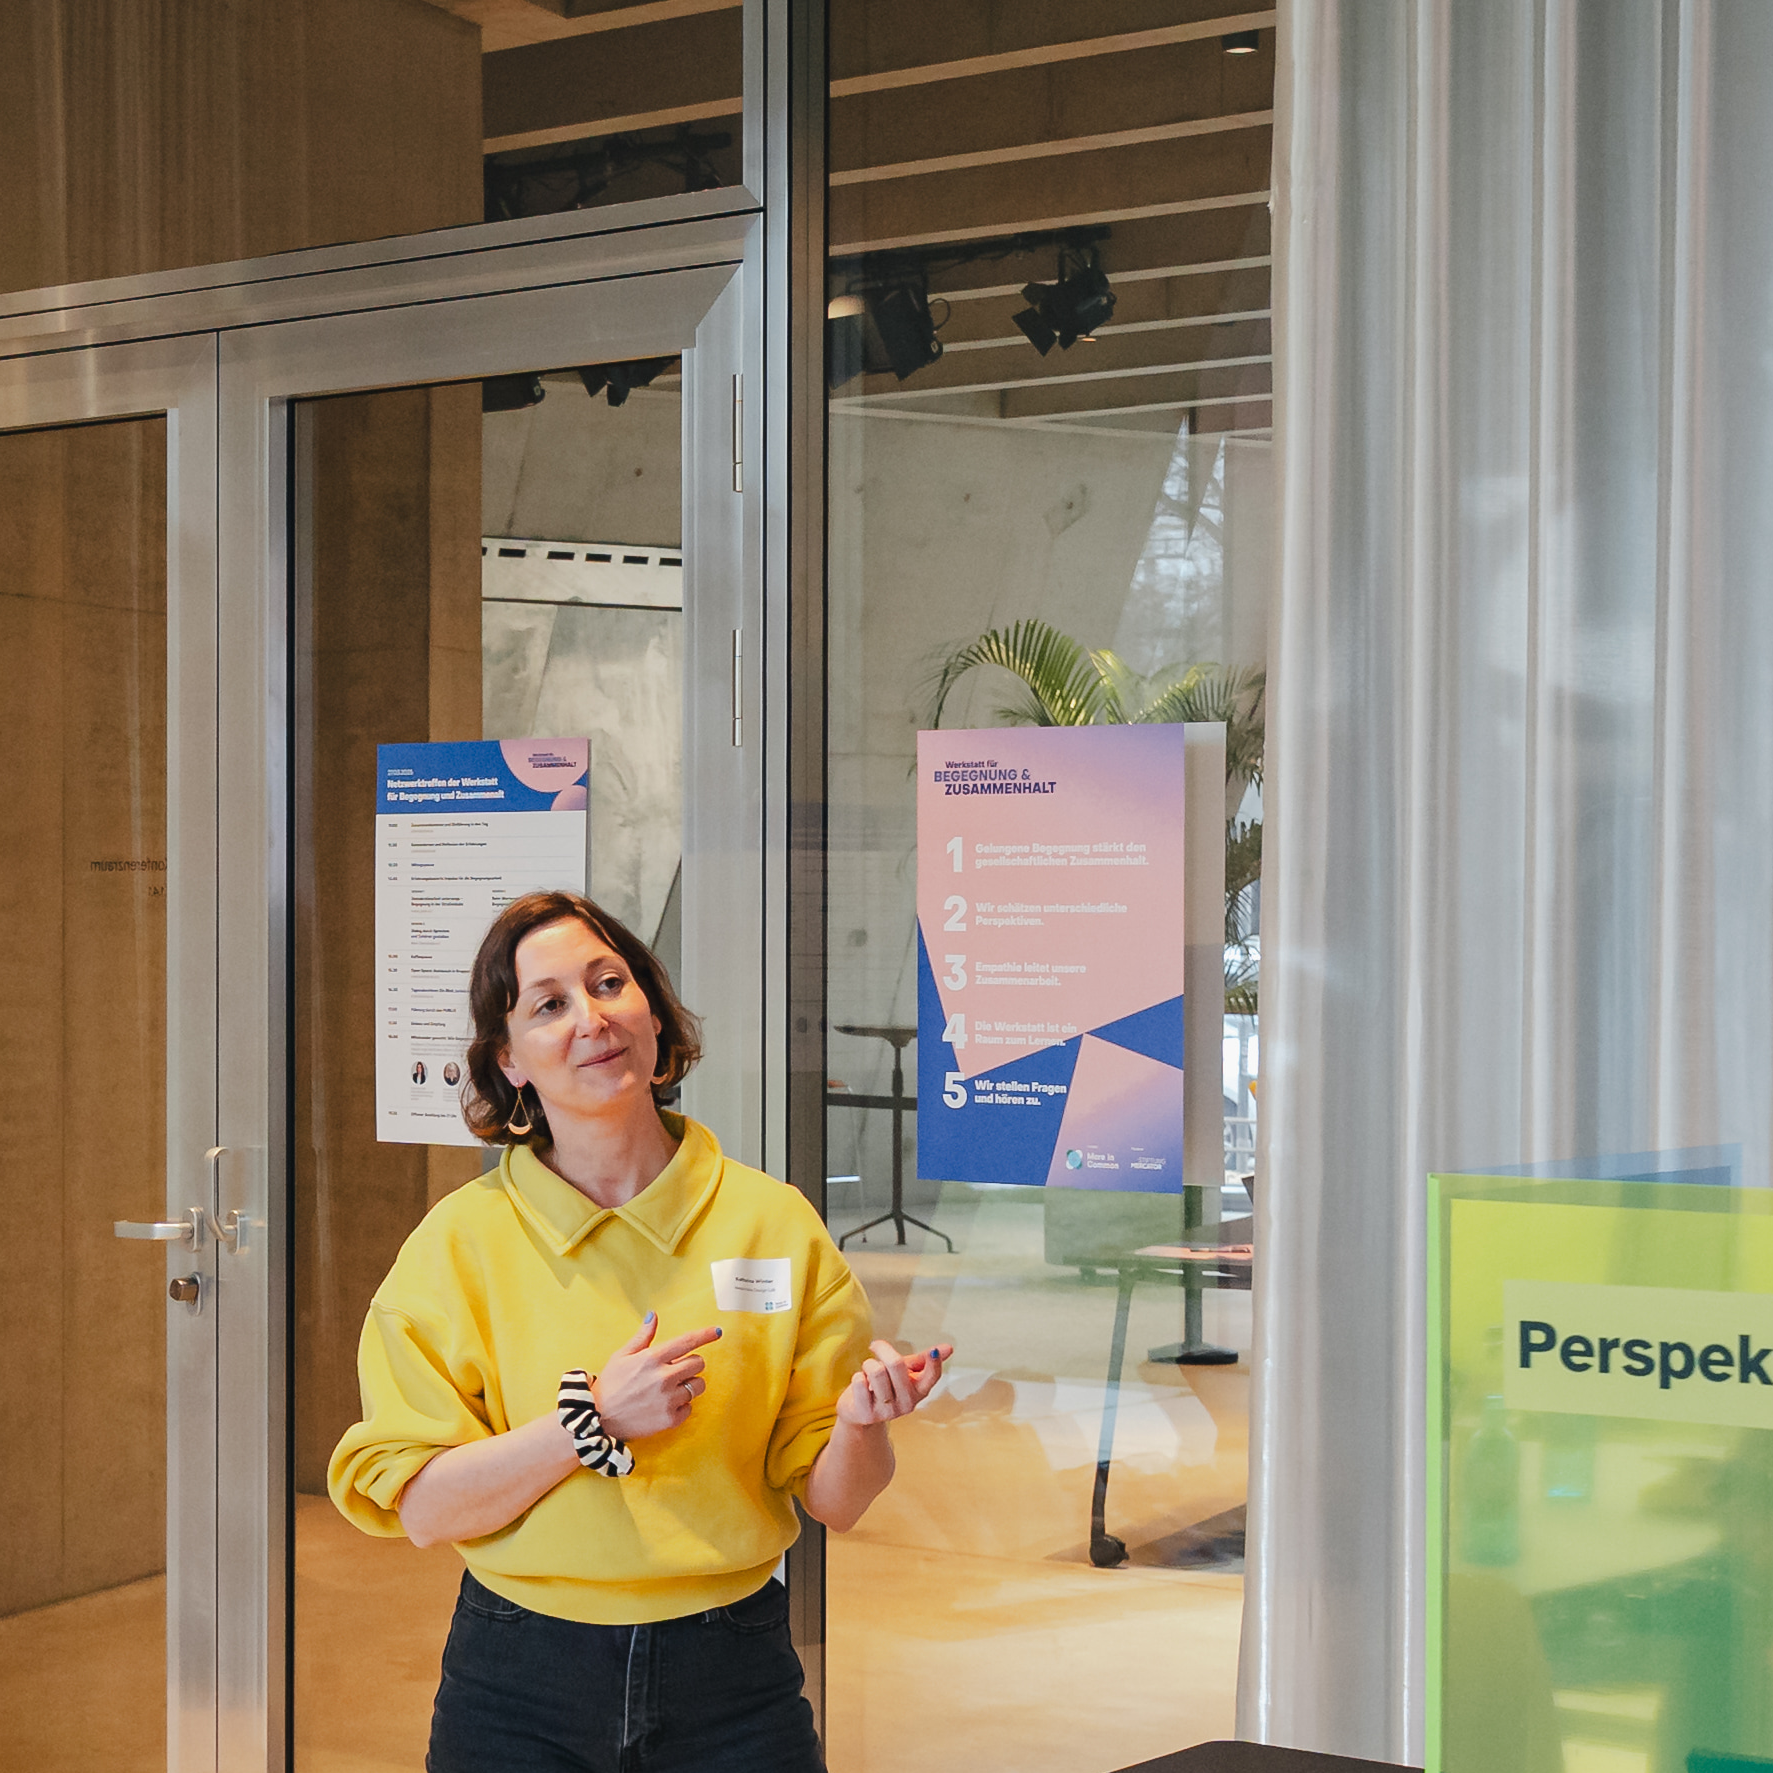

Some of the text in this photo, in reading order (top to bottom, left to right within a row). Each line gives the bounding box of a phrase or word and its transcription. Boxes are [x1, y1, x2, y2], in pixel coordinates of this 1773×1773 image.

[945, 760, 998, 769] Werkstatt für
[934, 768, 1031, 782] BEGEGNUNG &
[448, 778, 460, 787] der
[945, 782, 1057, 795] ZUSAMMENHALT
[947, 836, 963, 872] 1
[975, 841, 1146, 855] Gelungene Begegnung stärkt den
[975, 854, 1149, 869] gesellschaftlichen Zusammenhalt.
[944, 895, 967, 931] 2
[975, 902, 1127, 913] Wir schätzen unterschiedliche
[975, 915, 1044, 928] Perspektiven.
[943, 954, 967, 991] 3
[975, 961, 1087, 974] Empathie leitet unsere
[975, 975, 1061, 986] Zusammenarbeit.
[942, 1013, 968, 1049] 4
[975, 1021, 1077, 1033] Die Werkstatt ist ein
[975, 1034, 1066, 1046] Raum zum Lernen.
[942, 1071, 967, 1109] 5
[974, 1080, 1067, 1096] Wir stellen Fragen
[974, 1094, 1041, 1106] und hören zu.
